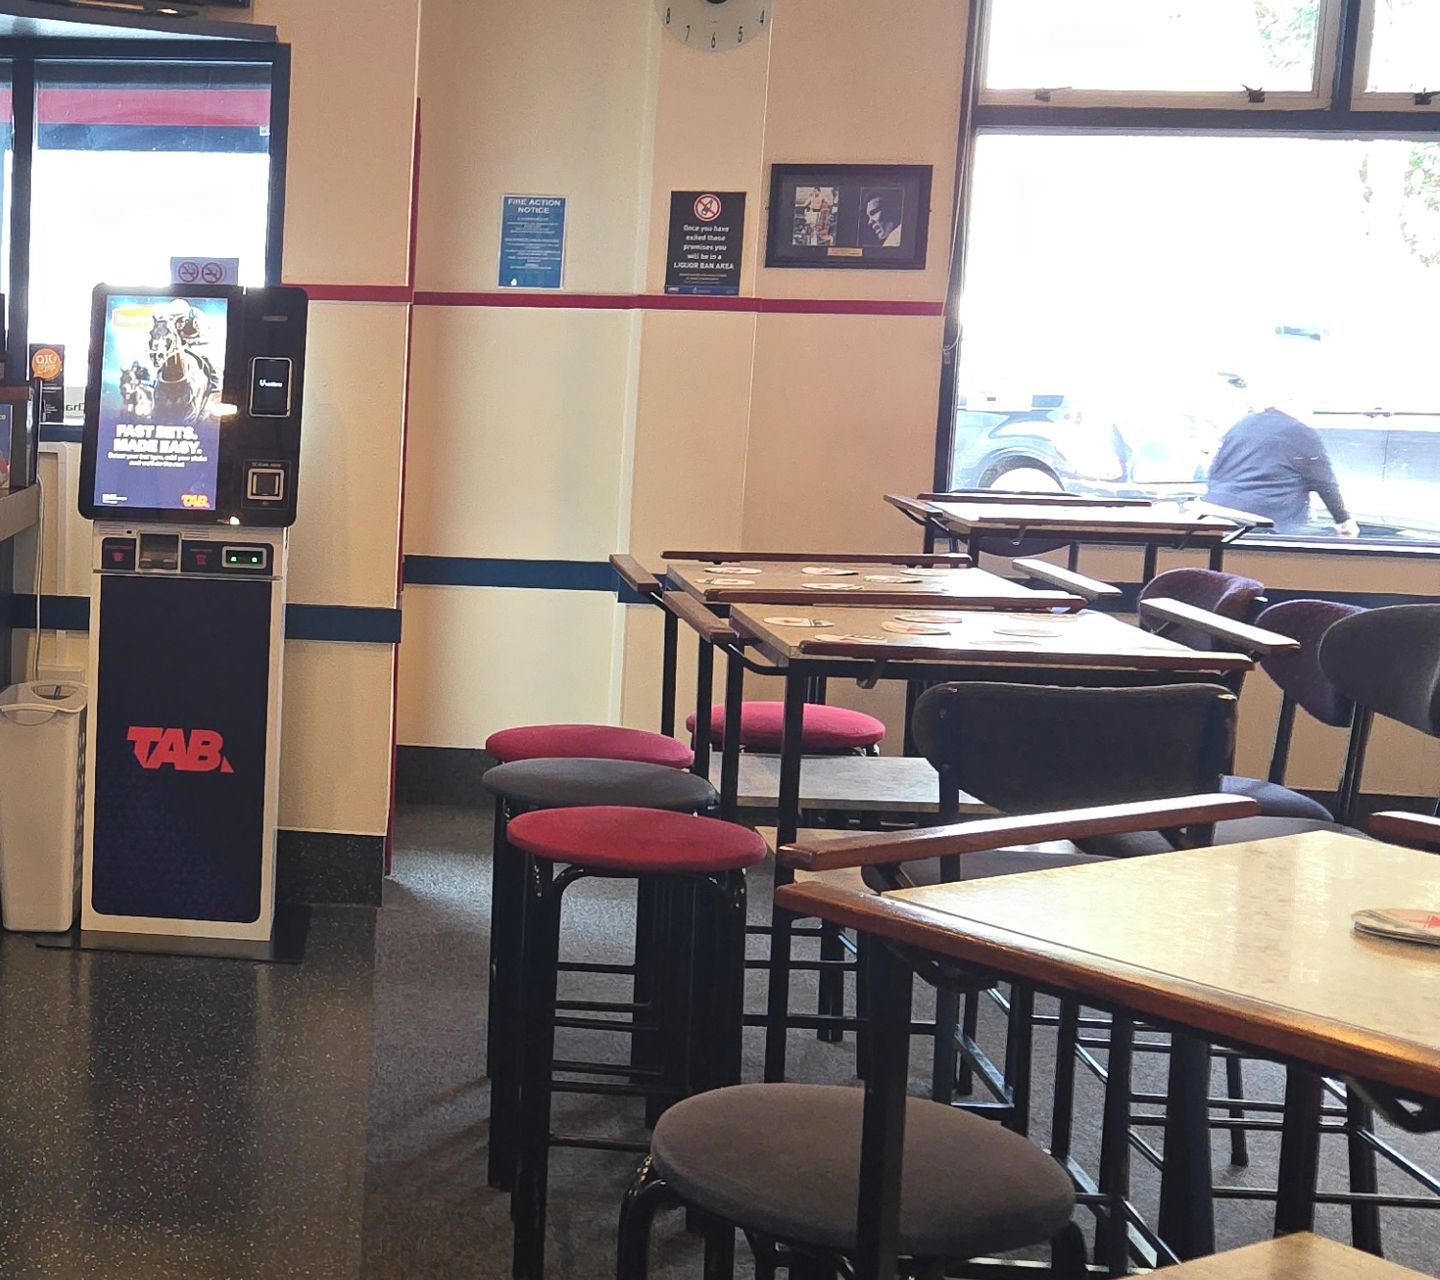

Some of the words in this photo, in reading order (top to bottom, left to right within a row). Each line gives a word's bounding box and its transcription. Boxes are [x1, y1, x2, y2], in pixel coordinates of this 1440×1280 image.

[665, 8, 671, 25] 8
[759, 9, 765, 26] 4
[686, 25, 691, 42] 7
[711, 32, 716, 49] 6
[737, 26, 743, 43] 5
[528, 199, 561, 207] ACTION
[683, 224, 700, 232] Once
[673, 261, 699, 269] LIQUOR
[116, 424, 155, 438] FAST
[113, 438, 159, 453] MADE
